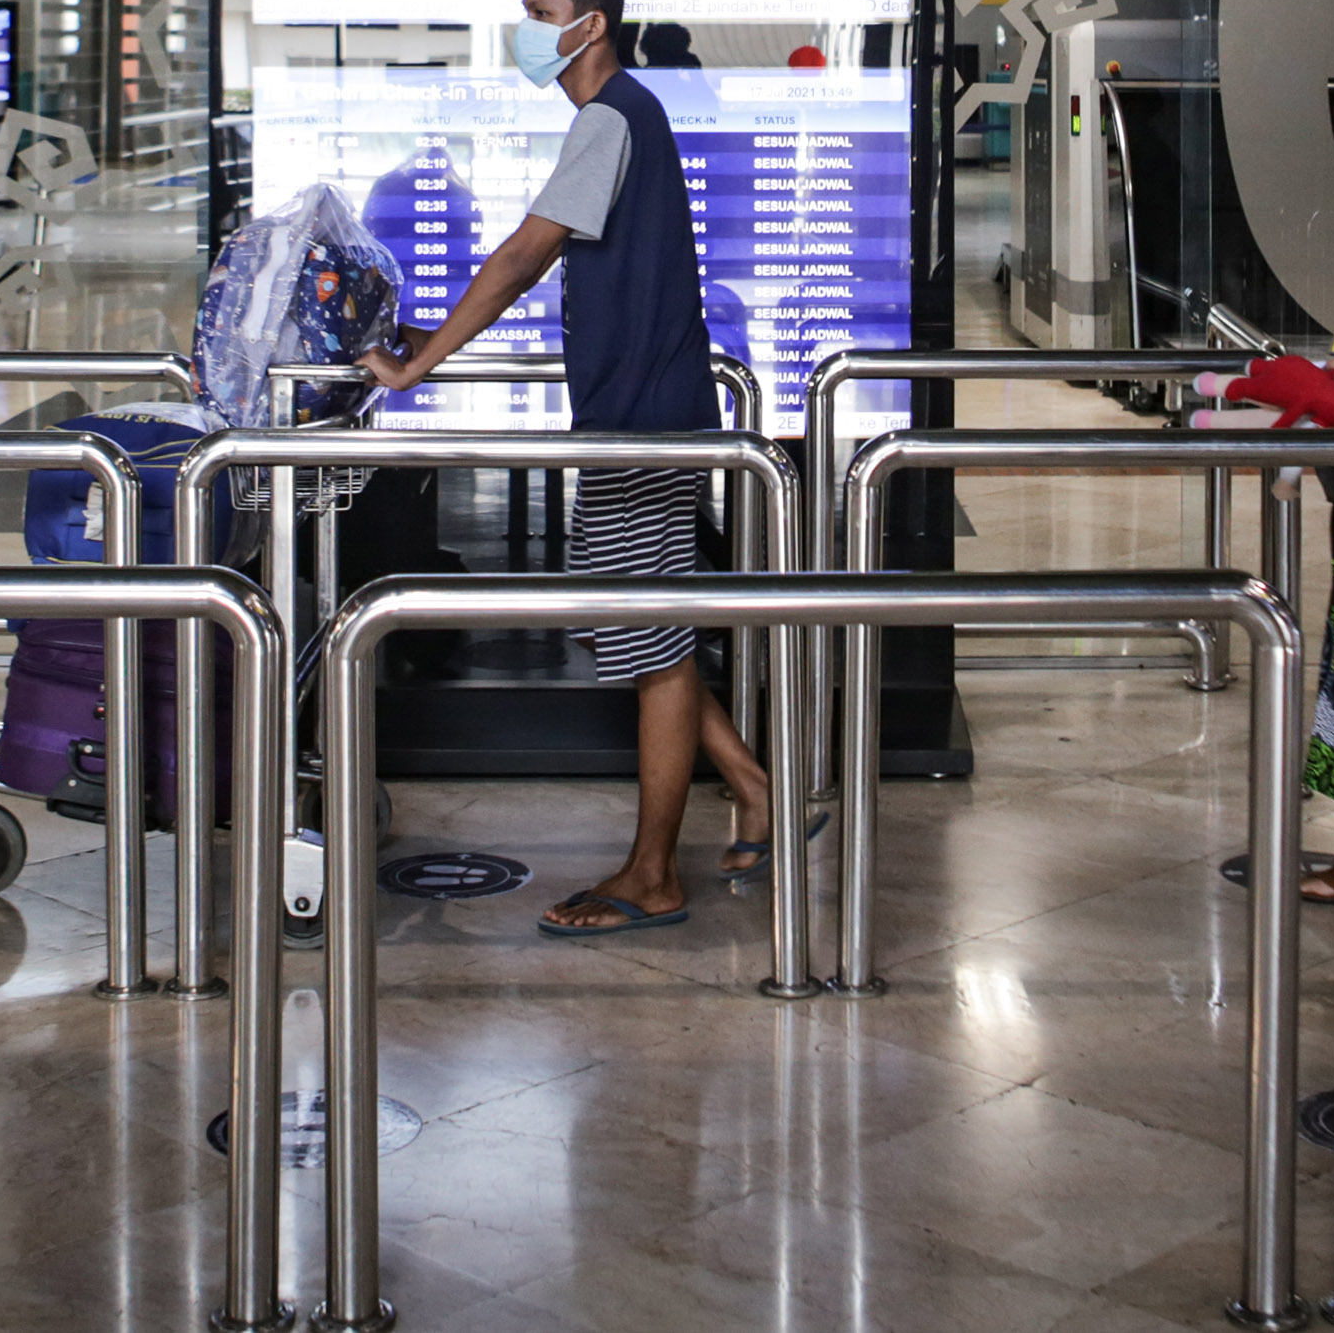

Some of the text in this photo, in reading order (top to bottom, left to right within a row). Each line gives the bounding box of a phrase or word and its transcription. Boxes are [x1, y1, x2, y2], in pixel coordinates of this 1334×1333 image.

[787, 88, 816, 97] 2021
[472, 116, 516, 124] TUJUAN
[755, 116, 795, 124] STATUS
[471, 137, 527, 148] TERNATE
[415, 159, 447, 169] 02:10
[415, 180, 447, 190] 02:30
[801, 180, 853, 190] JADWAL
[415, 201, 447, 212] 02:35
[801, 201, 853, 212] JADWAL
[415, 222, 853, 234] 02:50 SESUAI JADWAL
[415, 244, 853, 255] 03:00 SESUAI JADWAL
[415, 265, 853, 276] 03:05 SESUAI JADWAL
[415, 286, 853, 298] 03:20 SESUAI JADWAL
[415, 308, 853, 319] 03:30 SESUAI JADWAL
[801, 329, 853, 340] JADWAL
